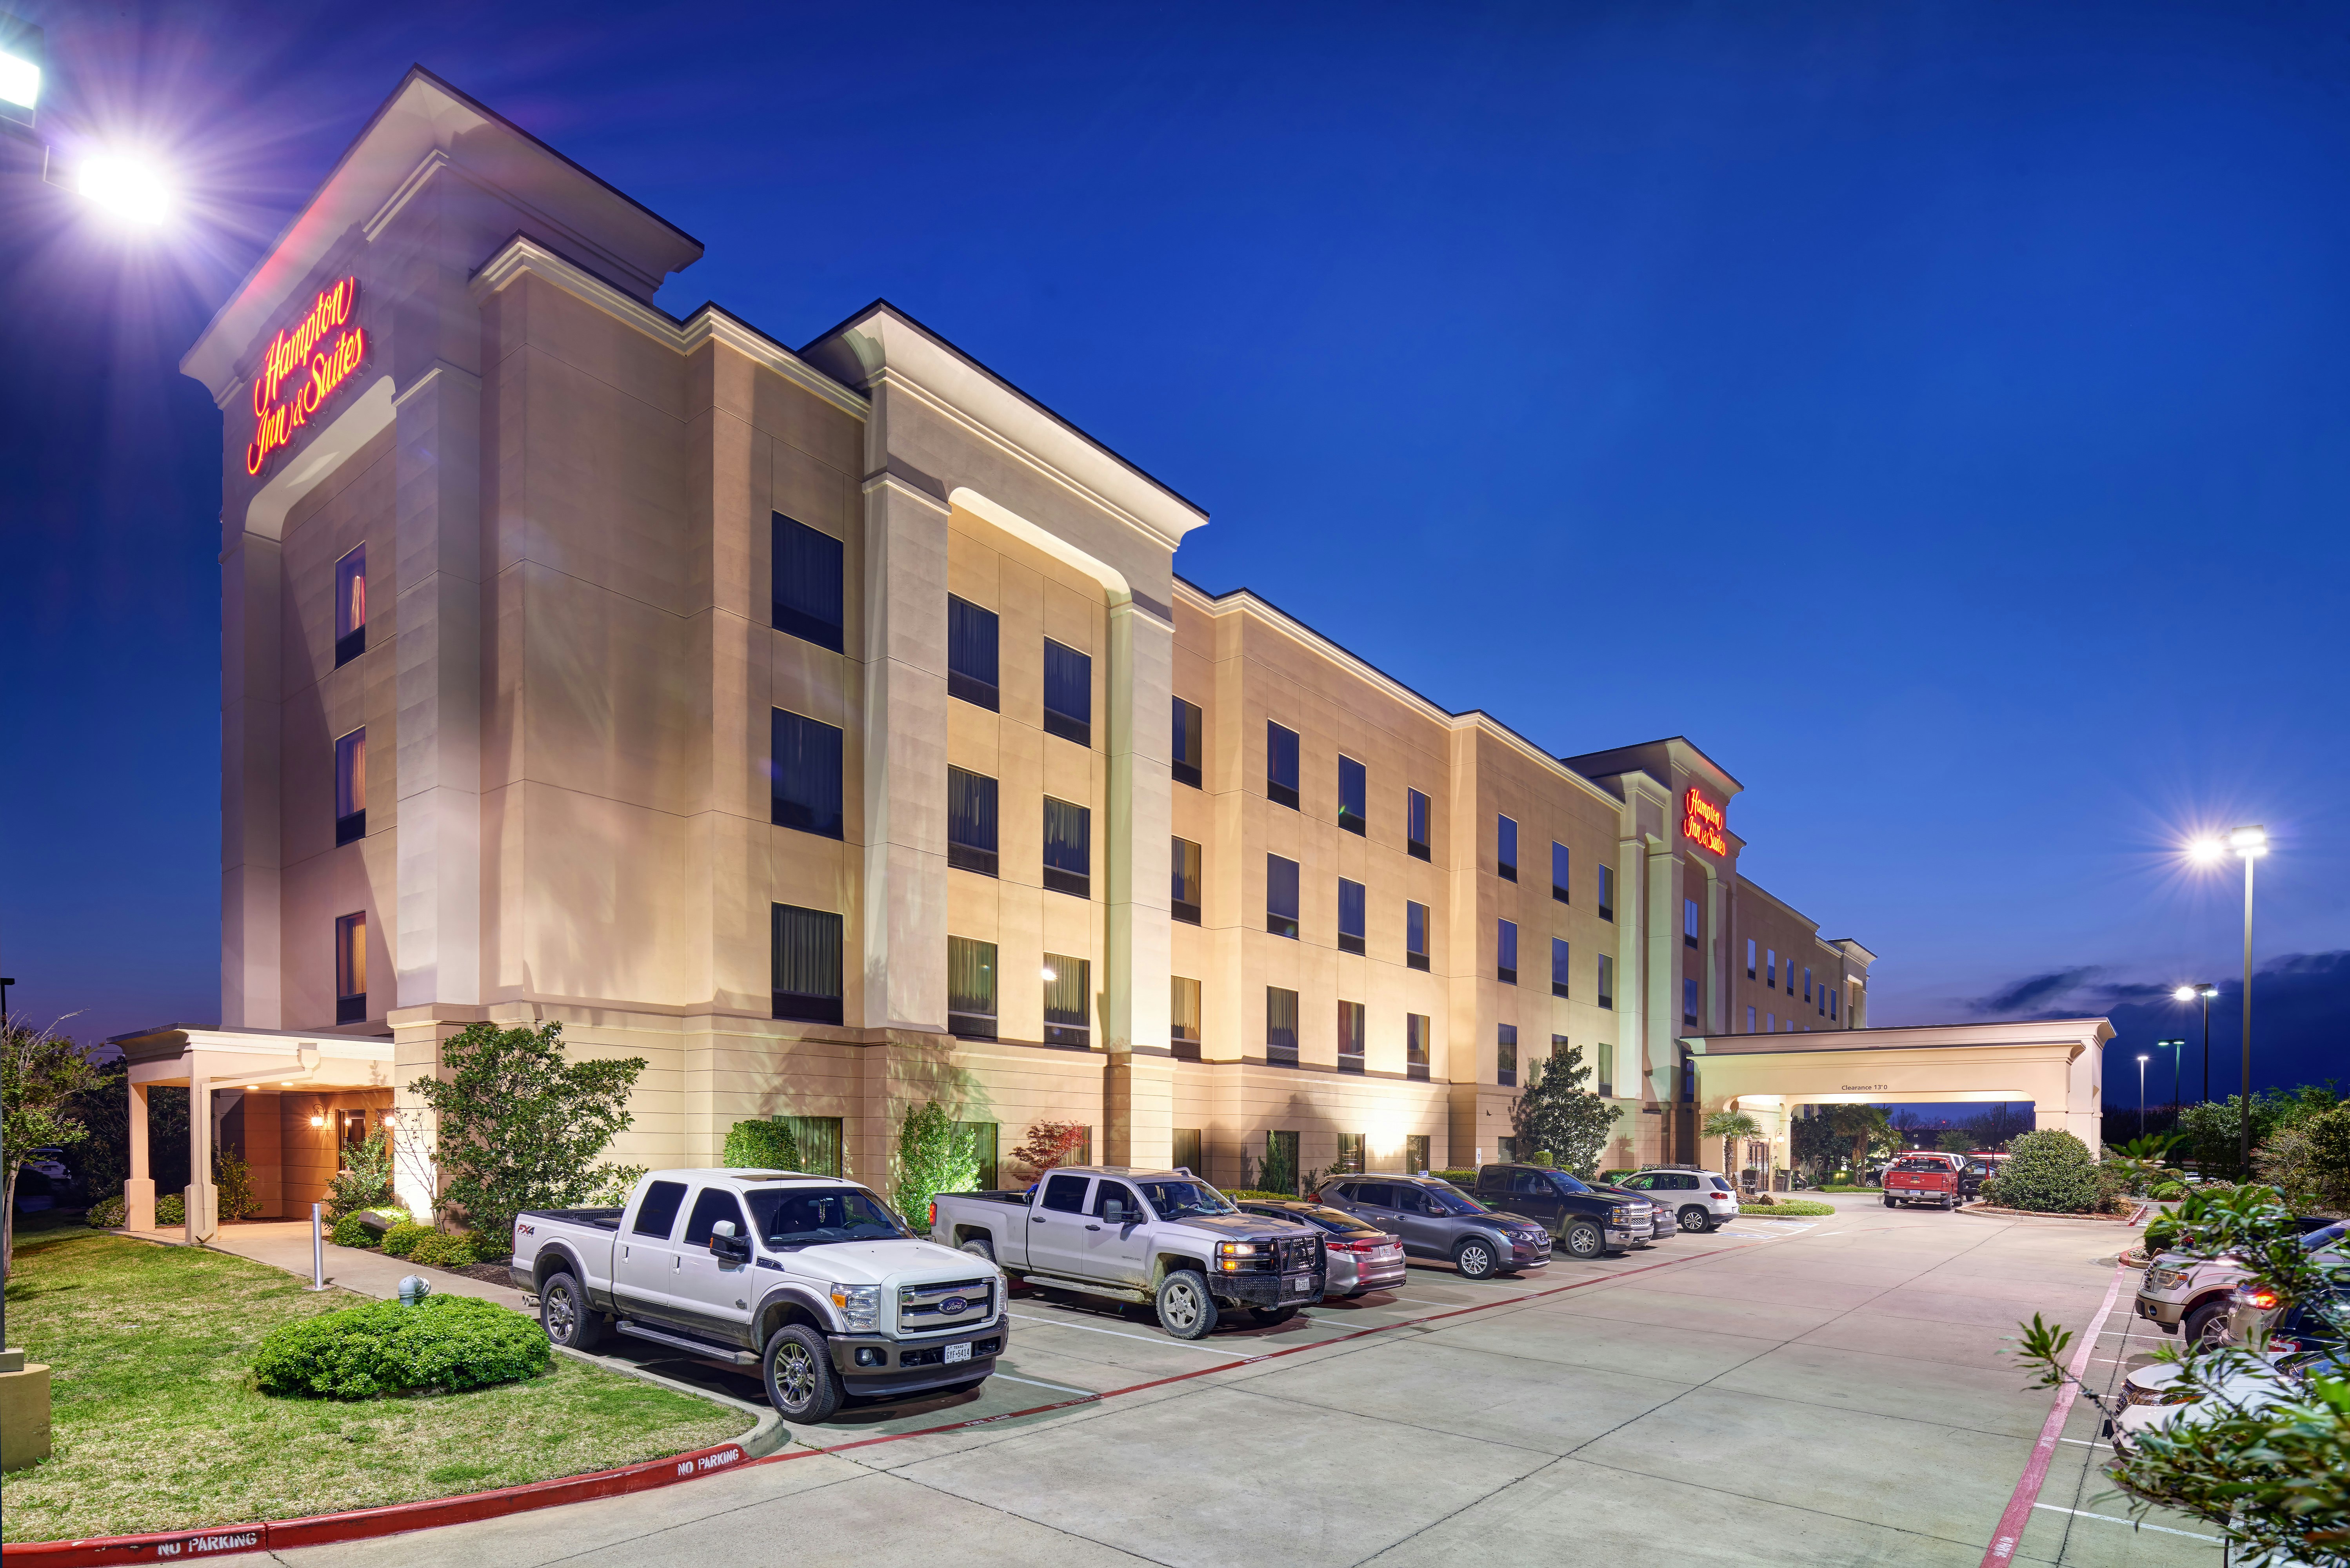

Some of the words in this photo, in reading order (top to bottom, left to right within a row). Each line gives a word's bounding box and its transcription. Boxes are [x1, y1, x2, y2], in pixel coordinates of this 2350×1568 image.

[255, 276, 354, 417] Hampton
[248, 401, 293, 475] Inn
[293, 388, 305, 426] &
[303, 327, 363, 413] Suites
[1687, 789, 1722, 830] Hampton
[1685, 816, 1703, 844] Inn
[1707, 827, 1725, 856] Suites
[517, 1224, 535, 1236] FX4
[947, 1301, 963, 1310] Ford
[776, 1337, 802, 1348] MICHELIN
[780, 1403, 808, 1414] MICHELIN
[678, 1461, 694, 1476] NO
[698, 1448, 739, 1470] PARKING
[157, 1542, 181, 1556] NO
[188, 1532, 257, 1552] PARKING
